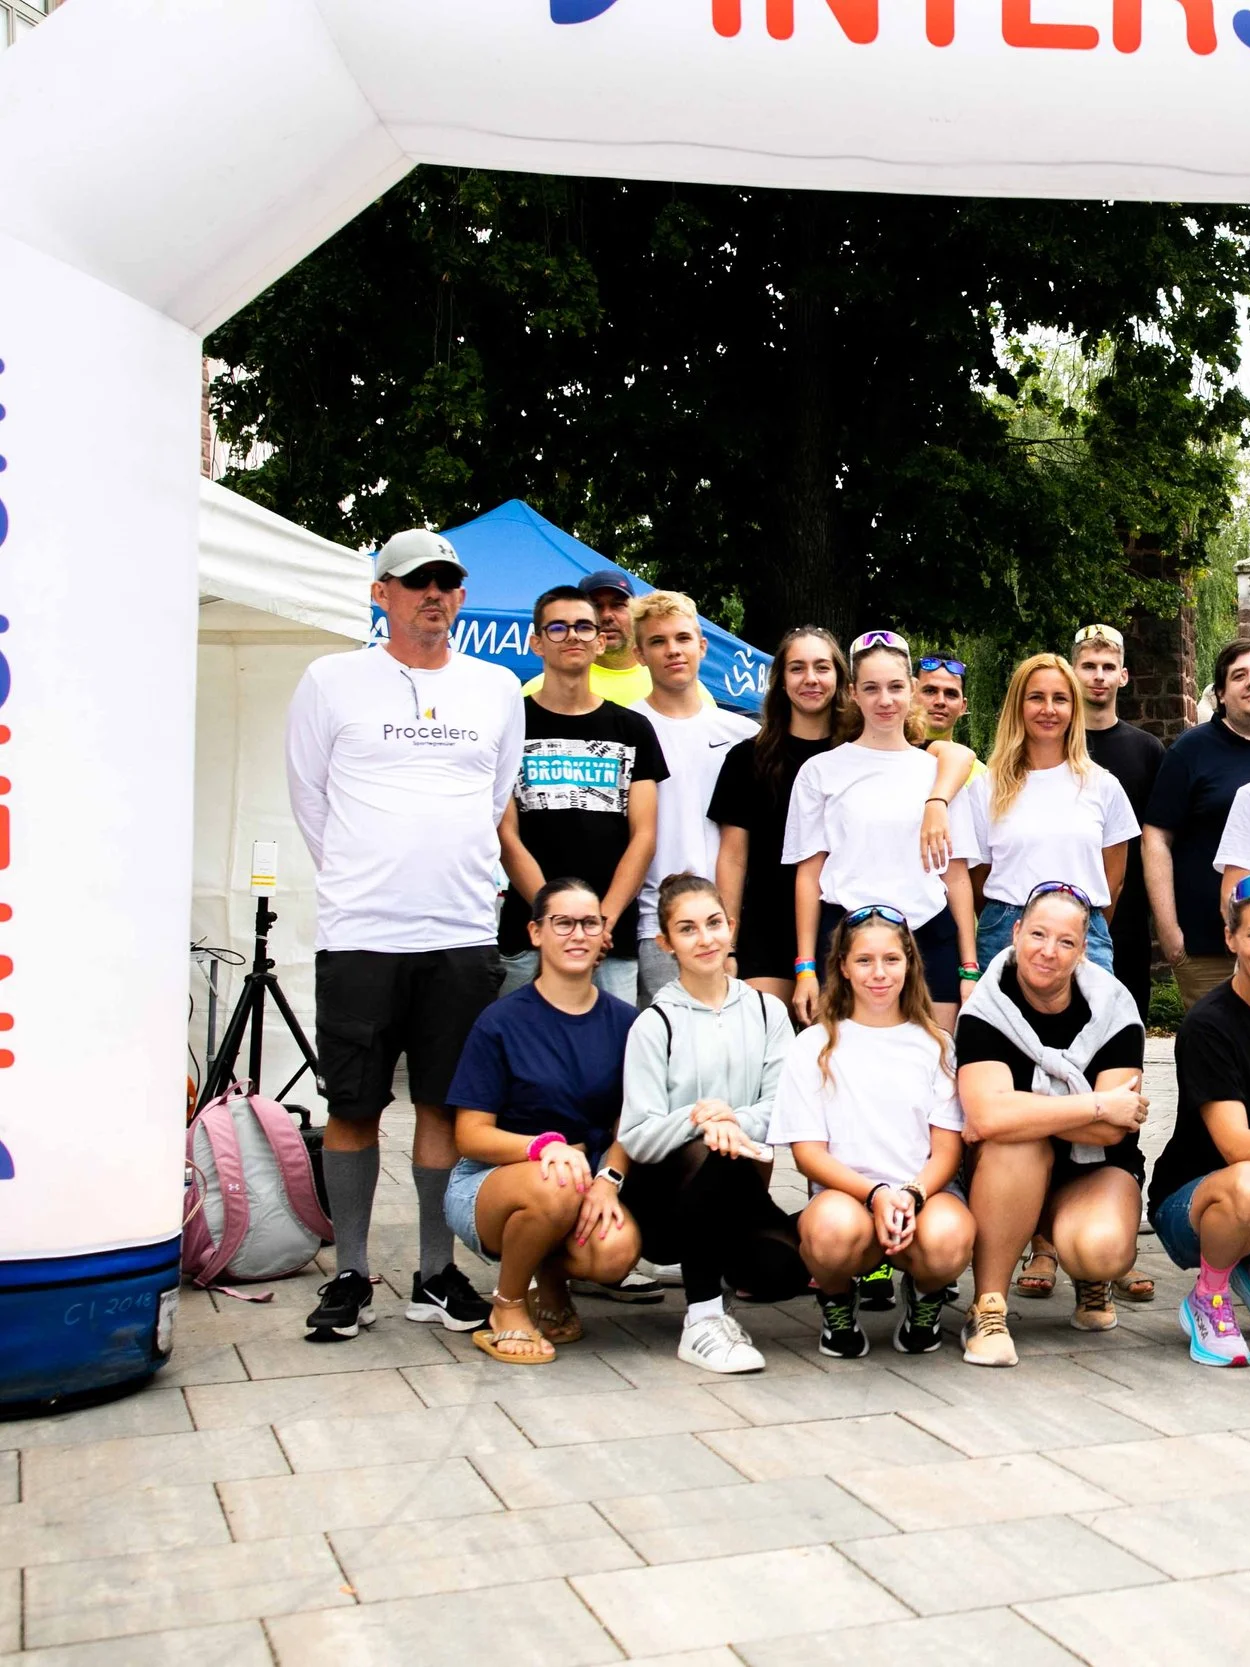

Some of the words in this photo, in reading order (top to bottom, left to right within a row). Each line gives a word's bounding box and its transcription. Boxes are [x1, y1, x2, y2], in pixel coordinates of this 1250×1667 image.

[383, 723, 479, 742] Procelero
[527, 760, 616, 783] BROOKLYN
[104, 1292, 153, 1315] 2018
